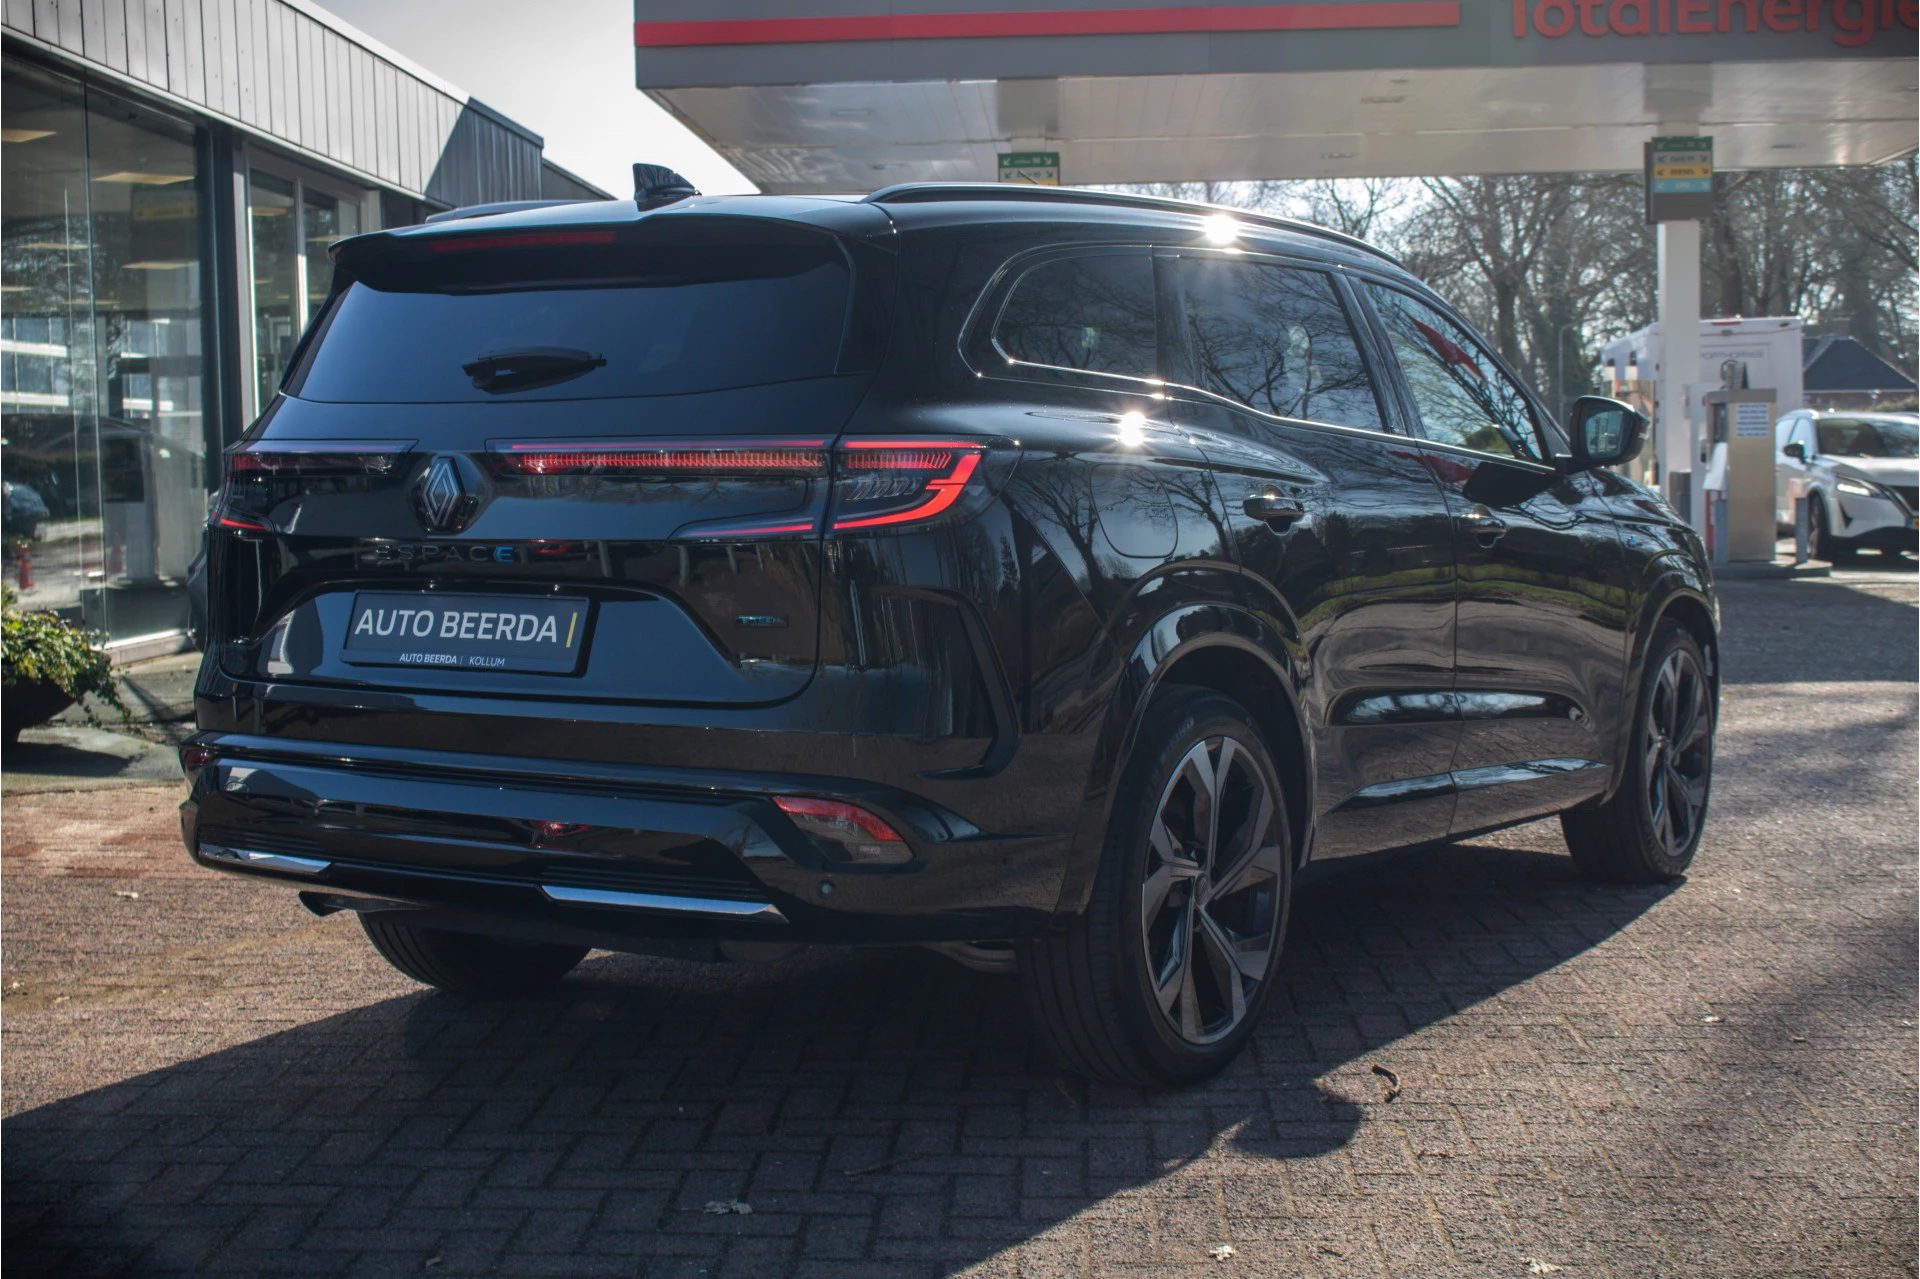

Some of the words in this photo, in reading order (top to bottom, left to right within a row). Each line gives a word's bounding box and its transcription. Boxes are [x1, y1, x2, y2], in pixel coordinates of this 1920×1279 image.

[376, 544, 514, 562] ESPACE
[354, 608, 434, 637] AUTO
[439, 611, 557, 643] BEERDA
[399, 653, 423, 662] AUTO
[423, 654, 457, 665] BEERDA
[469, 656, 505, 667] KOLLUM
